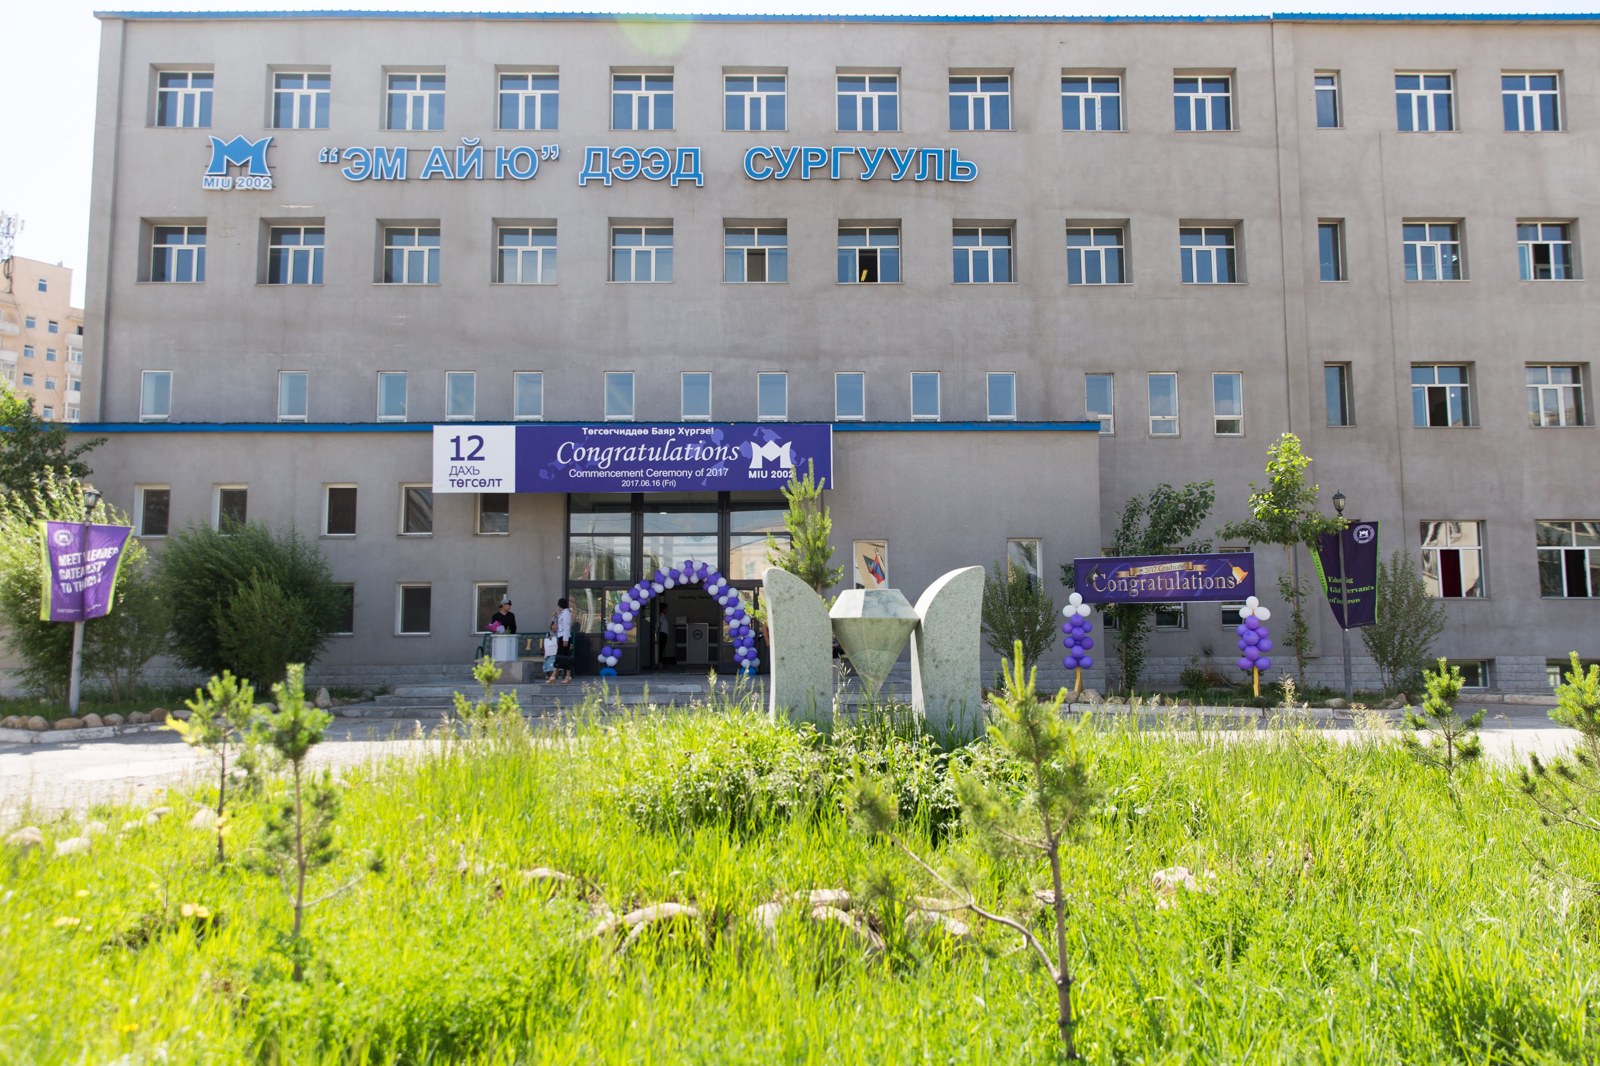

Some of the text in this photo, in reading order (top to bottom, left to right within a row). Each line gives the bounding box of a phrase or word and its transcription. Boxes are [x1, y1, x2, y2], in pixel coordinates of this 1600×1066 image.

[420, 137, 484, 180] АЙ
[578, 146, 704, 187] ДЭЭД
[743, 146, 979, 183] СУРГУУЛЬ
[203, 176, 273, 190] MIU 2002
[652, 427, 675, 436] Баяр
[450, 435, 485, 462] 12
[556, 438, 740, 469] Congratulations
[449, 466, 480, 477] ДАХЬ
[569, 467, 729, 479] Commencement Ceremony of 2017
[749, 471, 794, 479] MIU 2002
[1093, 571, 1236, 597] Congratulations
